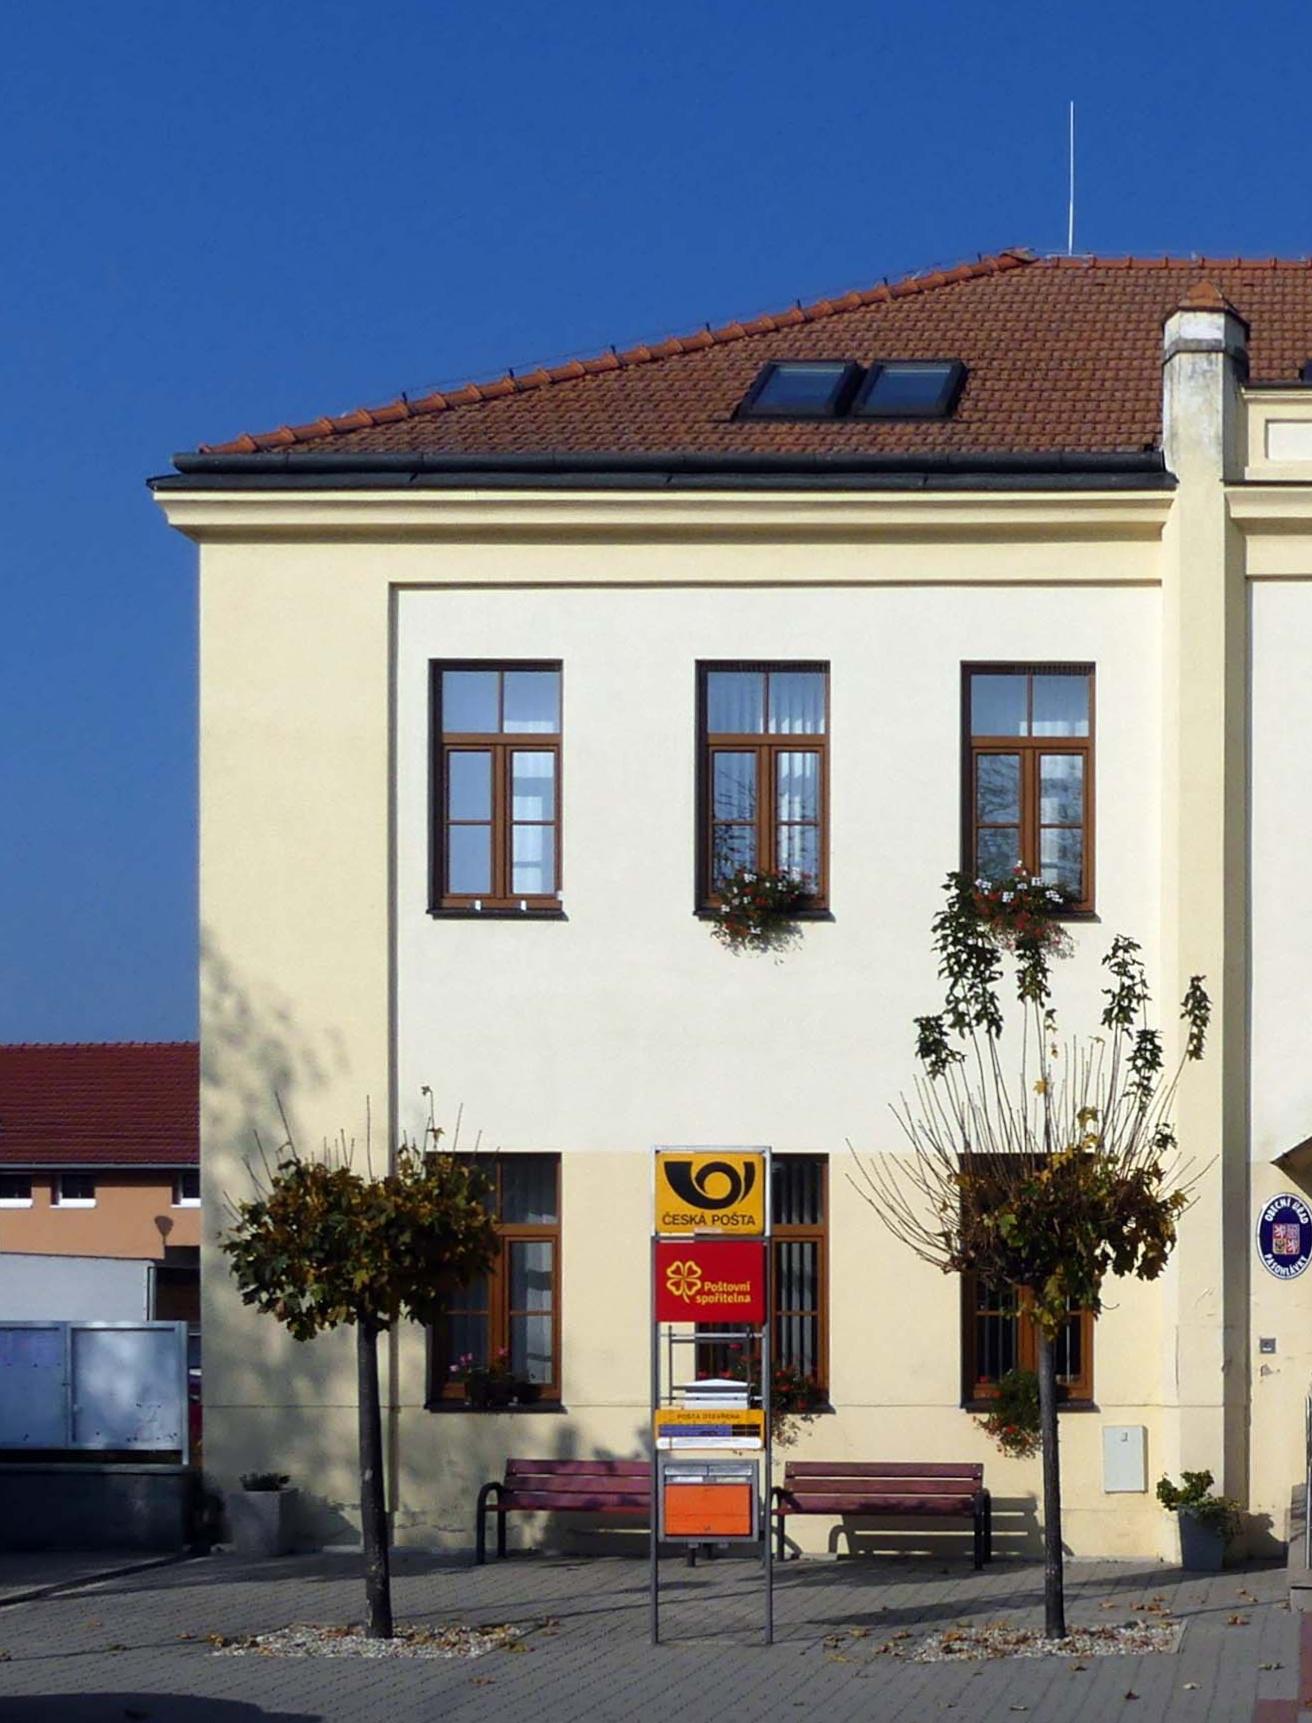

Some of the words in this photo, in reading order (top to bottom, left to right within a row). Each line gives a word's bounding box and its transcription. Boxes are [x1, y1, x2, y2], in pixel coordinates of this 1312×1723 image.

[662, 1211, 707, 1226] ČESKÁ
[711, 1211, 756, 1226] POŠTA
[703, 1281, 751, 1292] Poštovní
[695, 1293, 752, 1305] spořitelna
